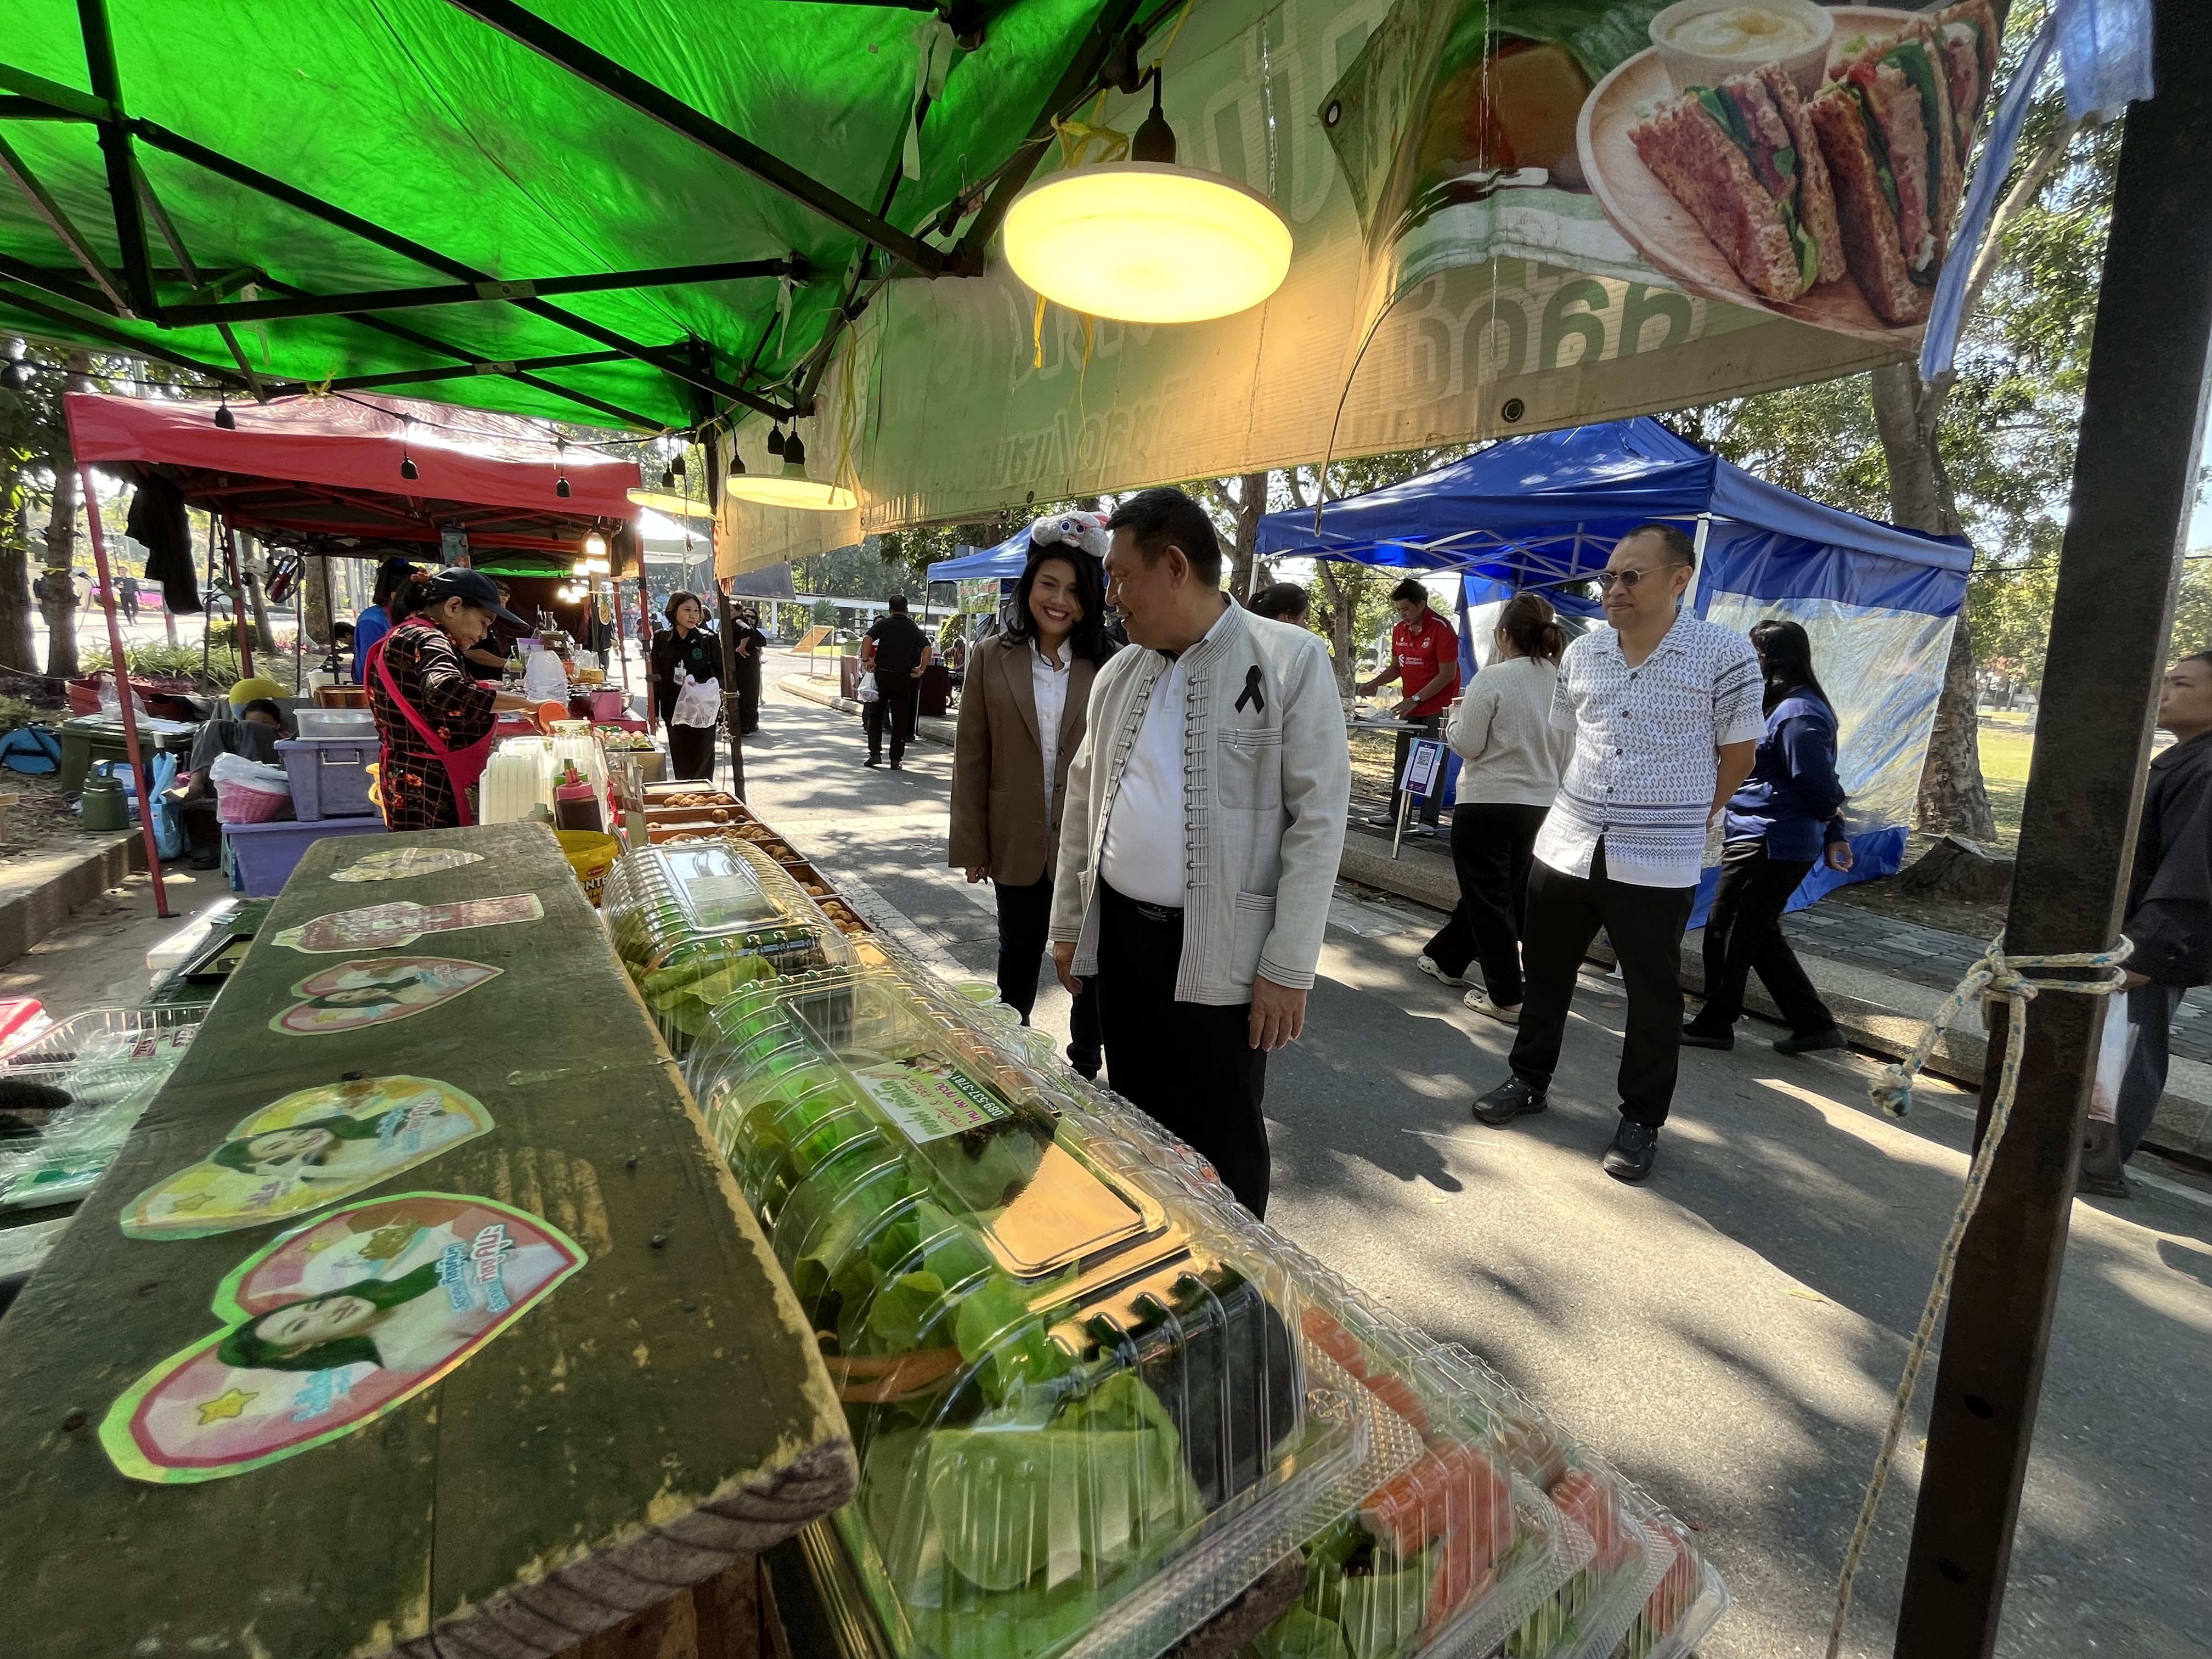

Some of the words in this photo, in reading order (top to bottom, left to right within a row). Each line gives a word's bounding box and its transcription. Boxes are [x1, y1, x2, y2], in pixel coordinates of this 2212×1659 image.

[934, 1082, 957, 1098] ทุกวัน
[951, 1074, 1005, 1117] 089-537-3781
[953, 1099, 969, 1109] สด
[964, 1109, 983, 1124] ใหม่
